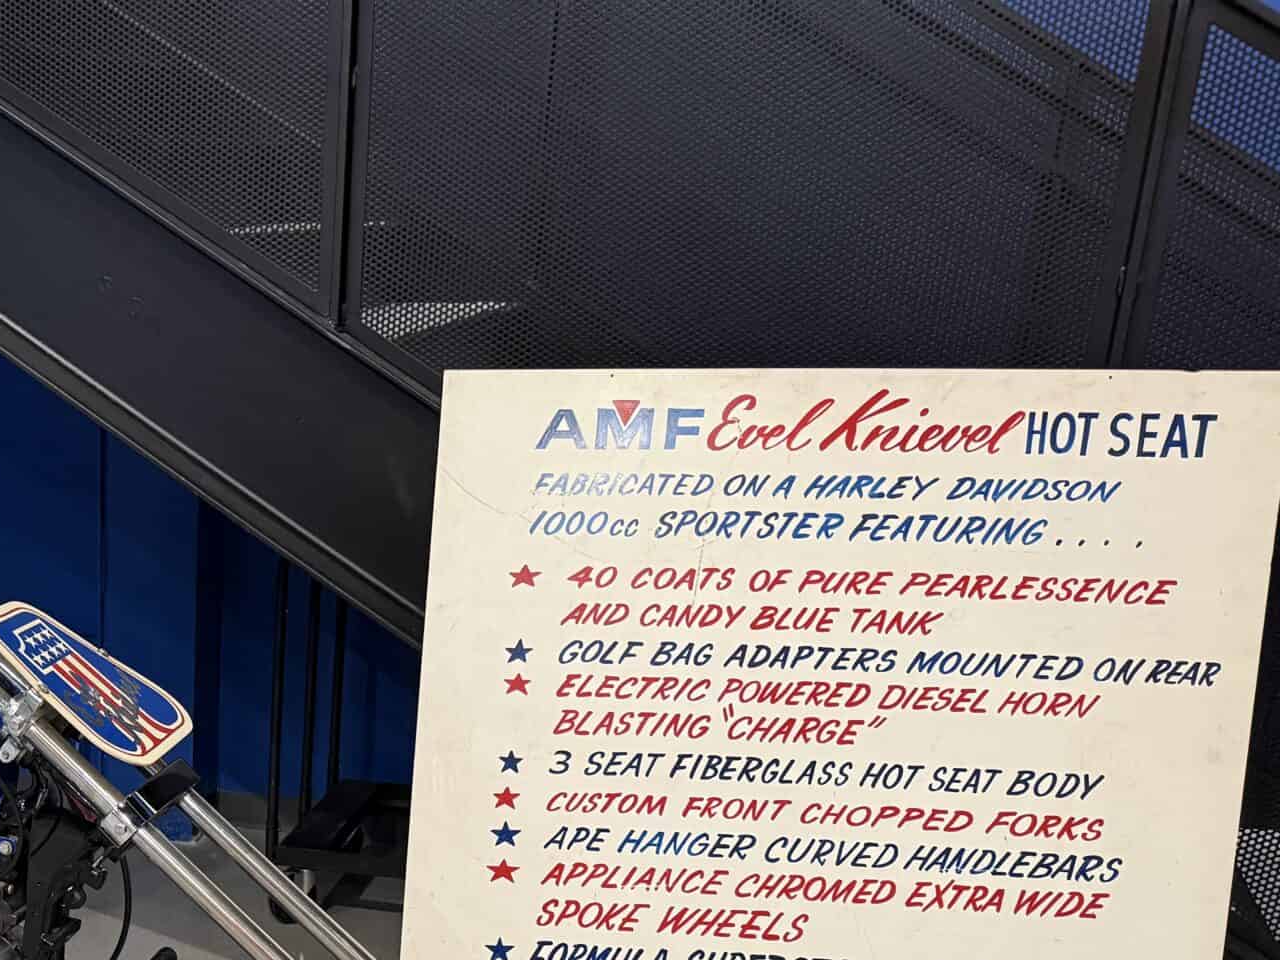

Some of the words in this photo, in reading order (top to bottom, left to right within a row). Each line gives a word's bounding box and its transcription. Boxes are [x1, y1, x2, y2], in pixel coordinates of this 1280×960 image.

[535, 400, 705, 450] AMF
[707, 394, 835, 452] Evel
[819, 389, 1026, 455] Knievel
[1025, 411, 1100, 456] HOT
[1108, 412, 1218, 458] SEAT
[533, 472, 714, 498] FABRICATED
[723, 474, 771, 498] ON
[773, 475, 801, 499] A
[803, 474, 941, 501] HARLEY
[946, 477, 1122, 503] DAVIDSON
[529, 511, 640, 538] 1000cc
[654, 511, 845, 540] SPORTSTER
[567, 566, 619, 591] 40
[630, 566, 736, 593] COATS
[748, 568, 794, 594] OF
[797, 569, 894, 596] PURE
[899, 572, 1178, 605] PEARLESSENCE
[560, 602, 630, 627] AND
[639, 603, 747, 630] CANDY
[749, 606, 840, 633] BLUE
[850, 608, 945, 636] TANK
[558, 640, 644, 666] GOLF
[649, 641, 714, 668] BAG
[723, 644, 898, 673] ADAPTERS
[906, 649, 1084, 682] MOUNTED
[1093, 657, 1144, 686] ON
[1144, 659, 1222, 688] REAR
[555, 673, 712, 702] ELECTRIC
[720, 678, 872, 709] POWERED
[877, 684, 988, 715] DIESEL
[997, 690, 1101, 720] HORN
[552, 709, 713, 740] BLASTING
[548, 750, 572, 775] 3
[584, 750, 666, 778] SEAT
[668, 752, 853, 788] FIBERGLASS
[859, 762, 926, 792] HOT
[927, 766, 1004, 796] SEAT
[1005, 770, 1106, 802] BODY
[546, 792, 667, 817] CUSTOM
[681, 796, 793, 822] FRONT
[799, 802, 975, 834] CHOPPED
[985, 811, 1105, 842] FORKS
[543, 825, 611, 853] APE
[616, 829, 757, 862] HANGER
[764, 835, 900, 869] CURVED
[903, 844, 1124, 884] HANDLEBARS
[540, 862, 730, 897] APPLIANCE
[734, 873, 897, 906] CHROMED
[904, 879, 1007, 915] EXTRA
[1013, 888, 1112, 920] WIDE
[535, 898, 651, 933] SPOKE
[656, 905, 811, 944] WHEELS
